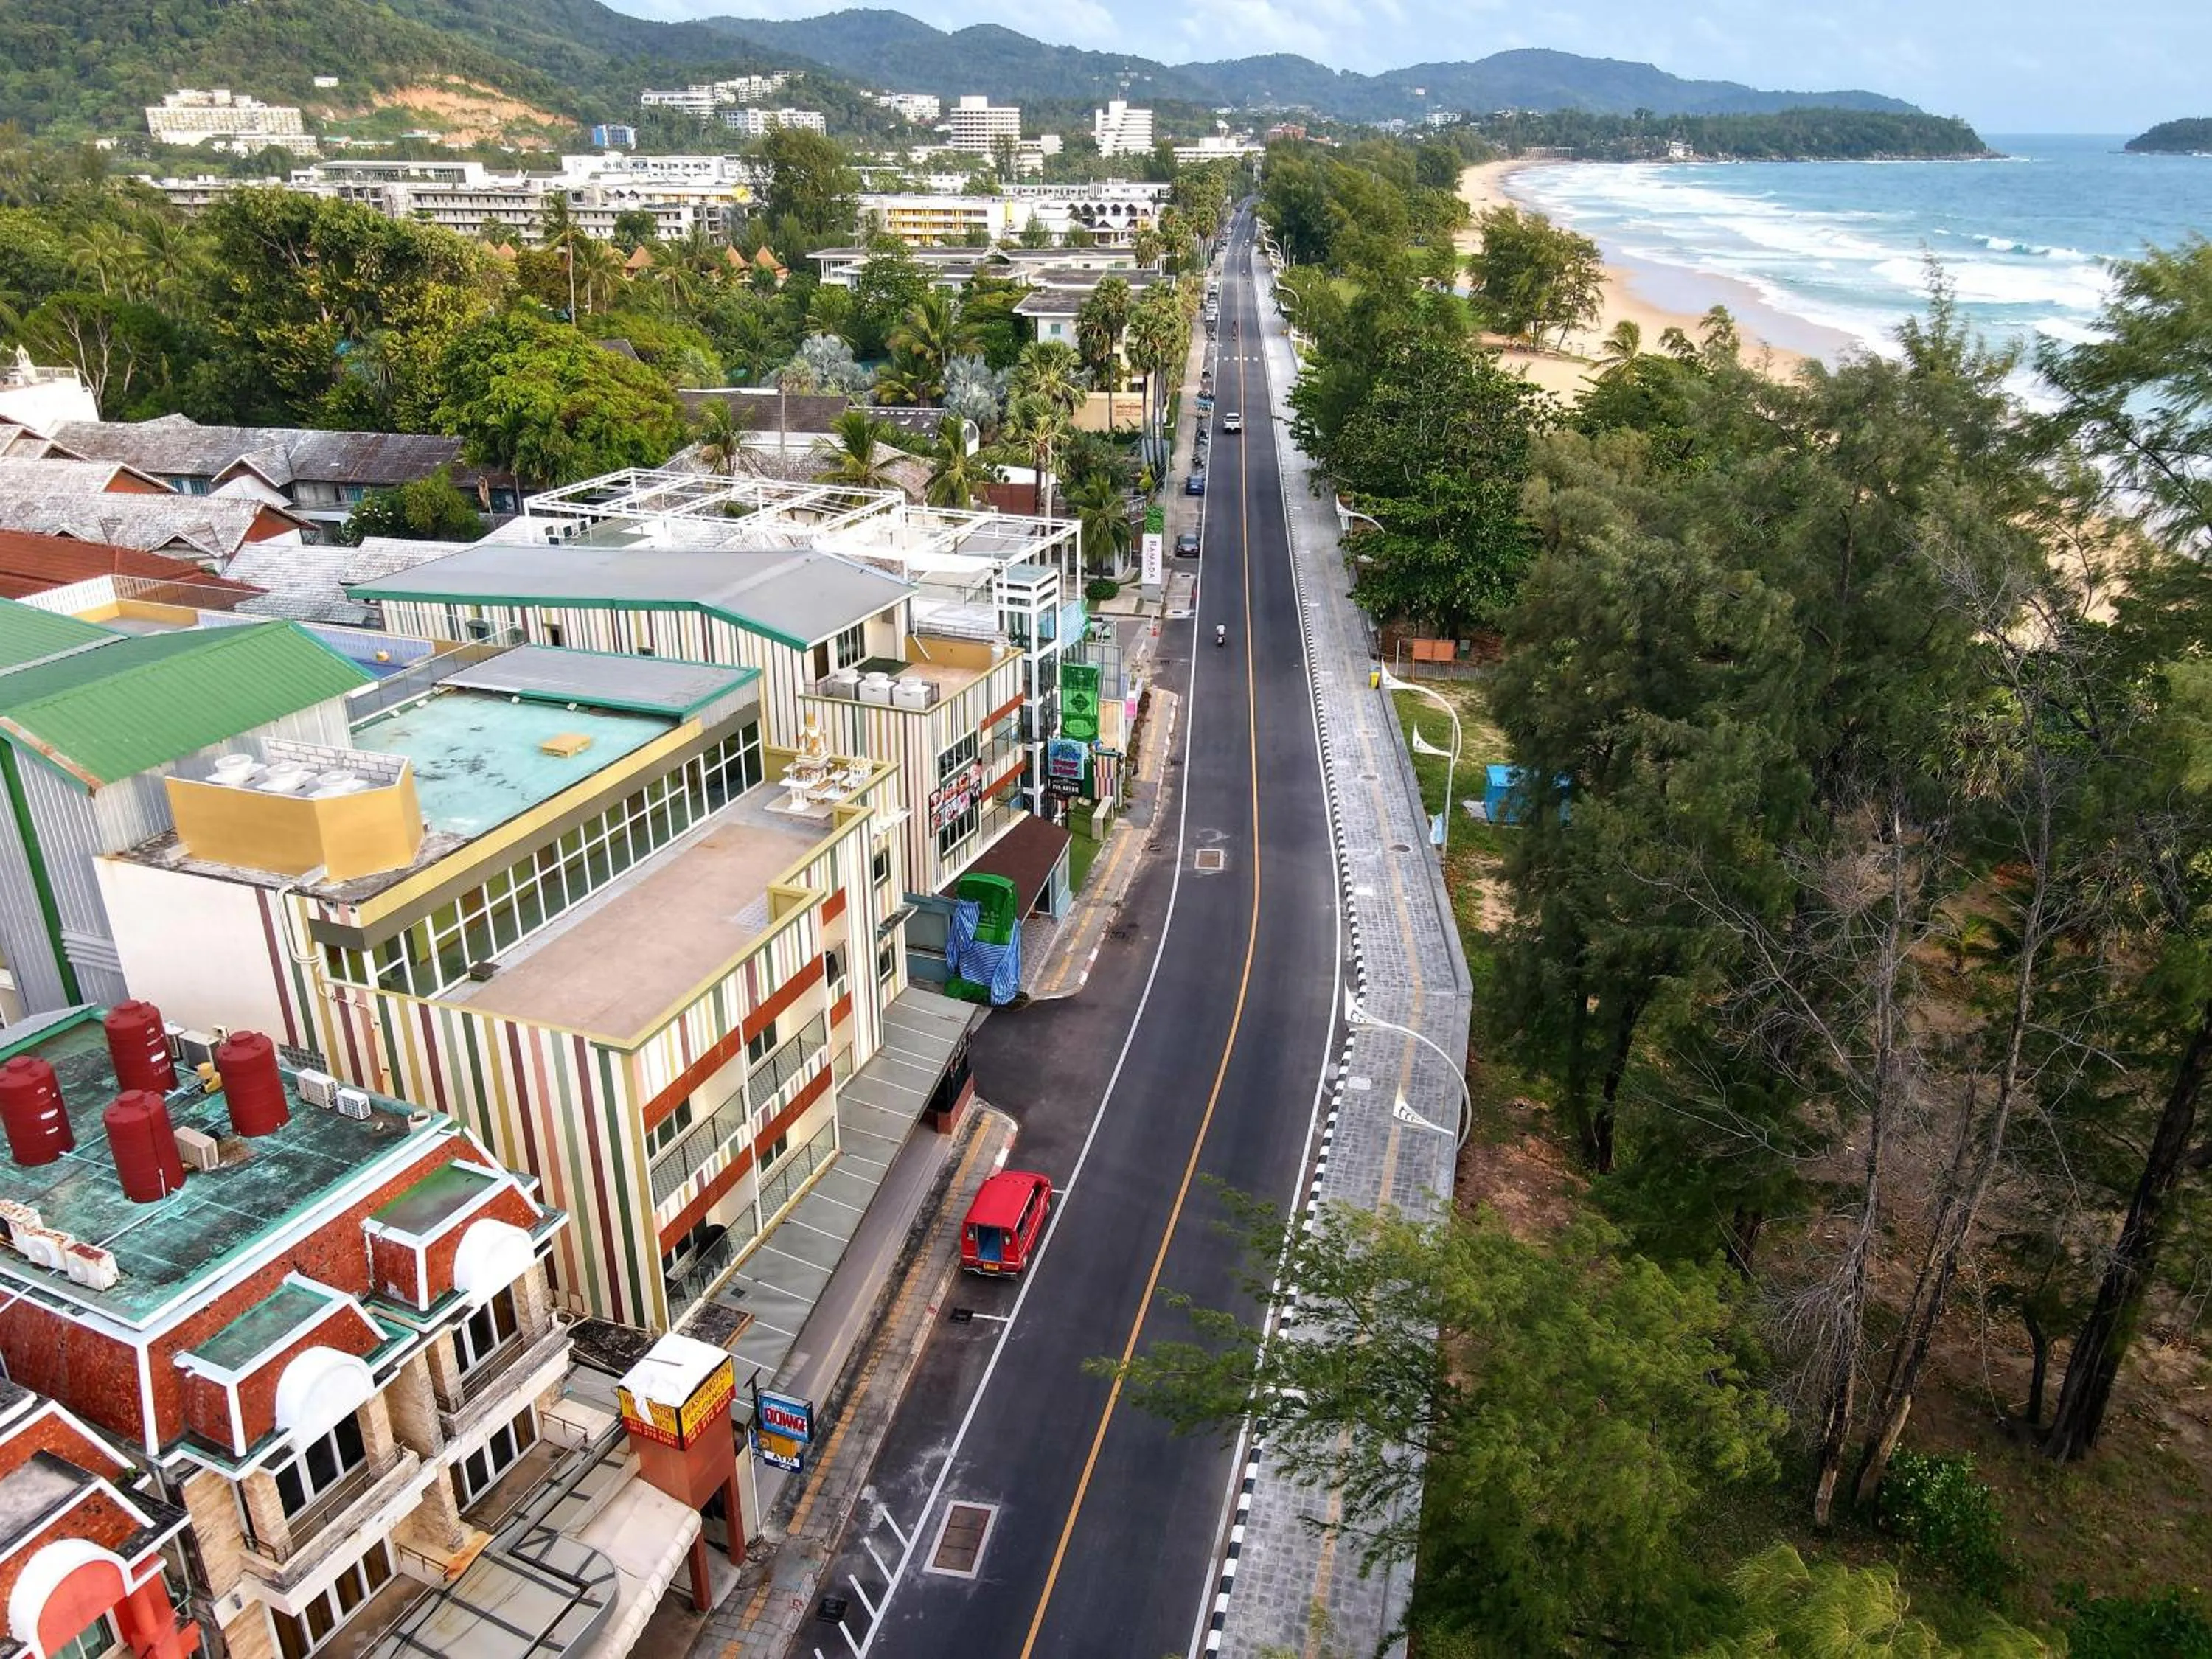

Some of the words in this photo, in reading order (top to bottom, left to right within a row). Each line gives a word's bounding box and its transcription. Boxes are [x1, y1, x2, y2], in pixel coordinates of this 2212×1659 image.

[1149, 540, 1157, 580] RAMADA
[683, 1364, 731, 1418] WASHINGTON
[690, 1383, 725, 1422] RESIDENCE
[765, 1408, 807, 1432] EXCHANGE
